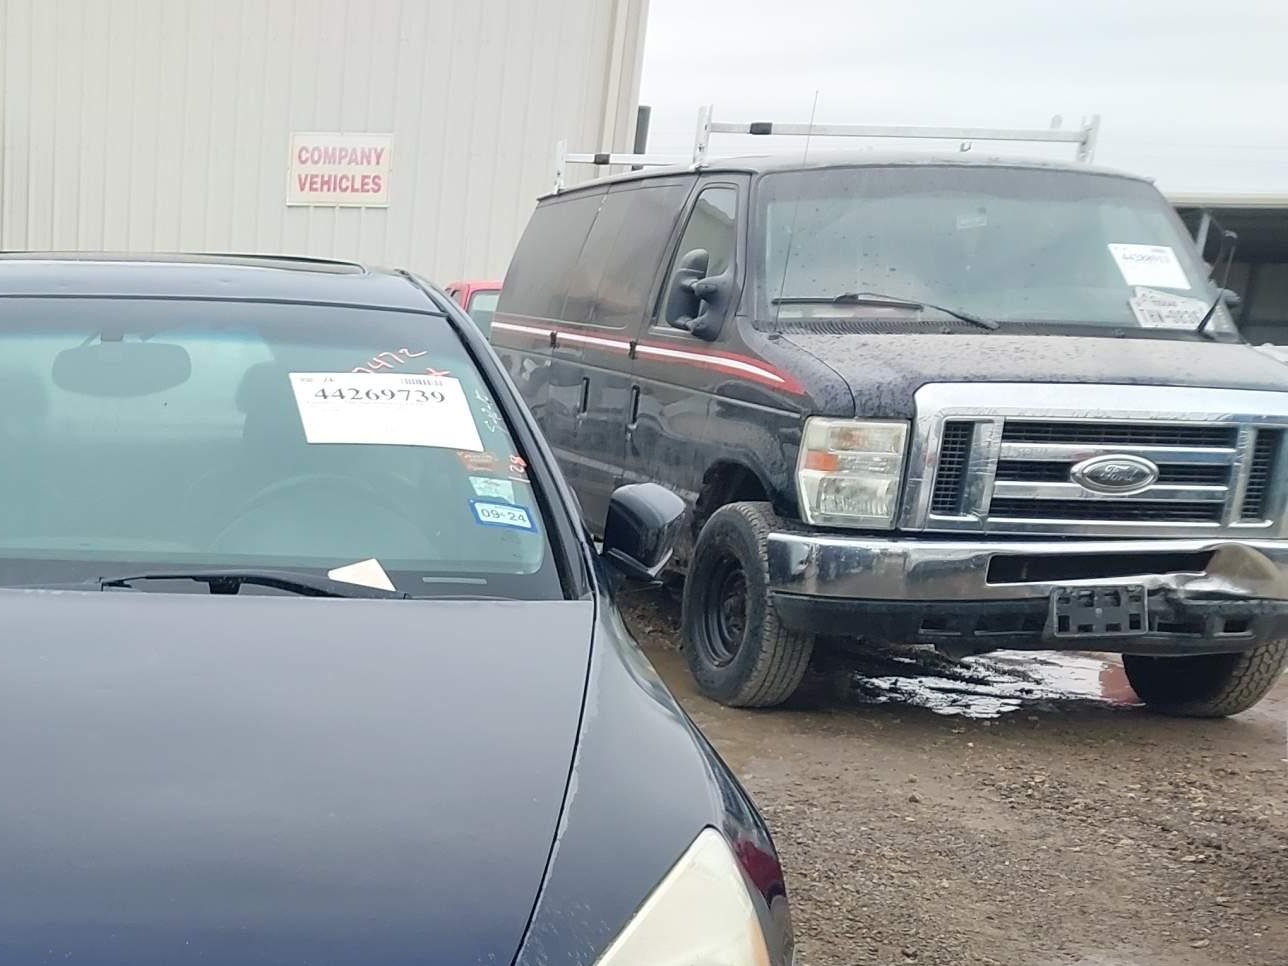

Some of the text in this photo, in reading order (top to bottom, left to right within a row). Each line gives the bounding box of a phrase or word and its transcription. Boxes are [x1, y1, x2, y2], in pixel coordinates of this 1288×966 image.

[297, 145, 385, 166] COMPANY
[297, 173, 382, 193] VEHICLES
[314, 387, 446, 404] 44269739
[1100, 464, 1139, 481] Ford
